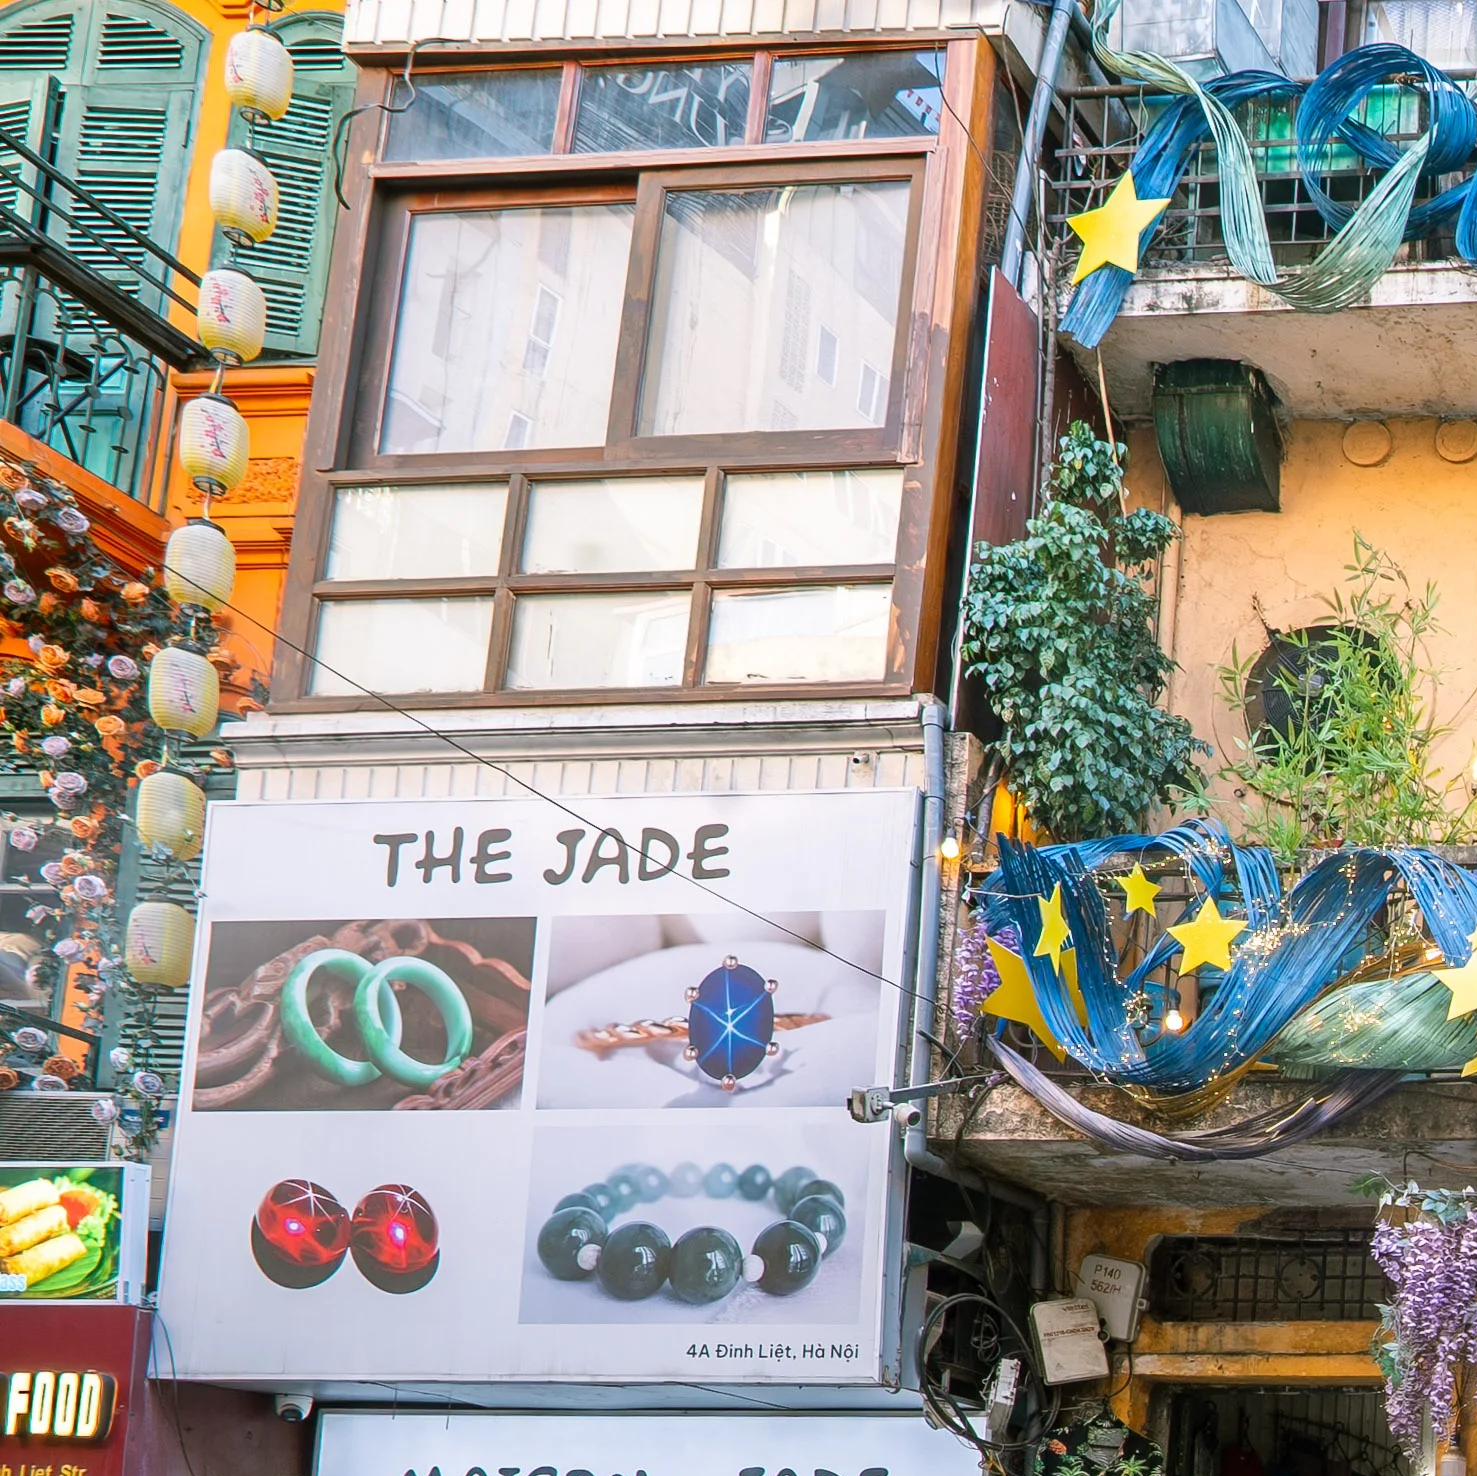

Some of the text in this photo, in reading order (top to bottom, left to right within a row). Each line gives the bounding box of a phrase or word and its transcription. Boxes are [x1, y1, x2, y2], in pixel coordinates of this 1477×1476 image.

[372, 822, 733, 889] THE JADE
[686, 1344, 710, 1359] 4A
[758, 1344, 797, 1362] Liệt,
[802, 1344, 825, 1359] Hà
[830, 1344, 859, 1362] Nội
[5, 1371, 102, 1438] FOOD
